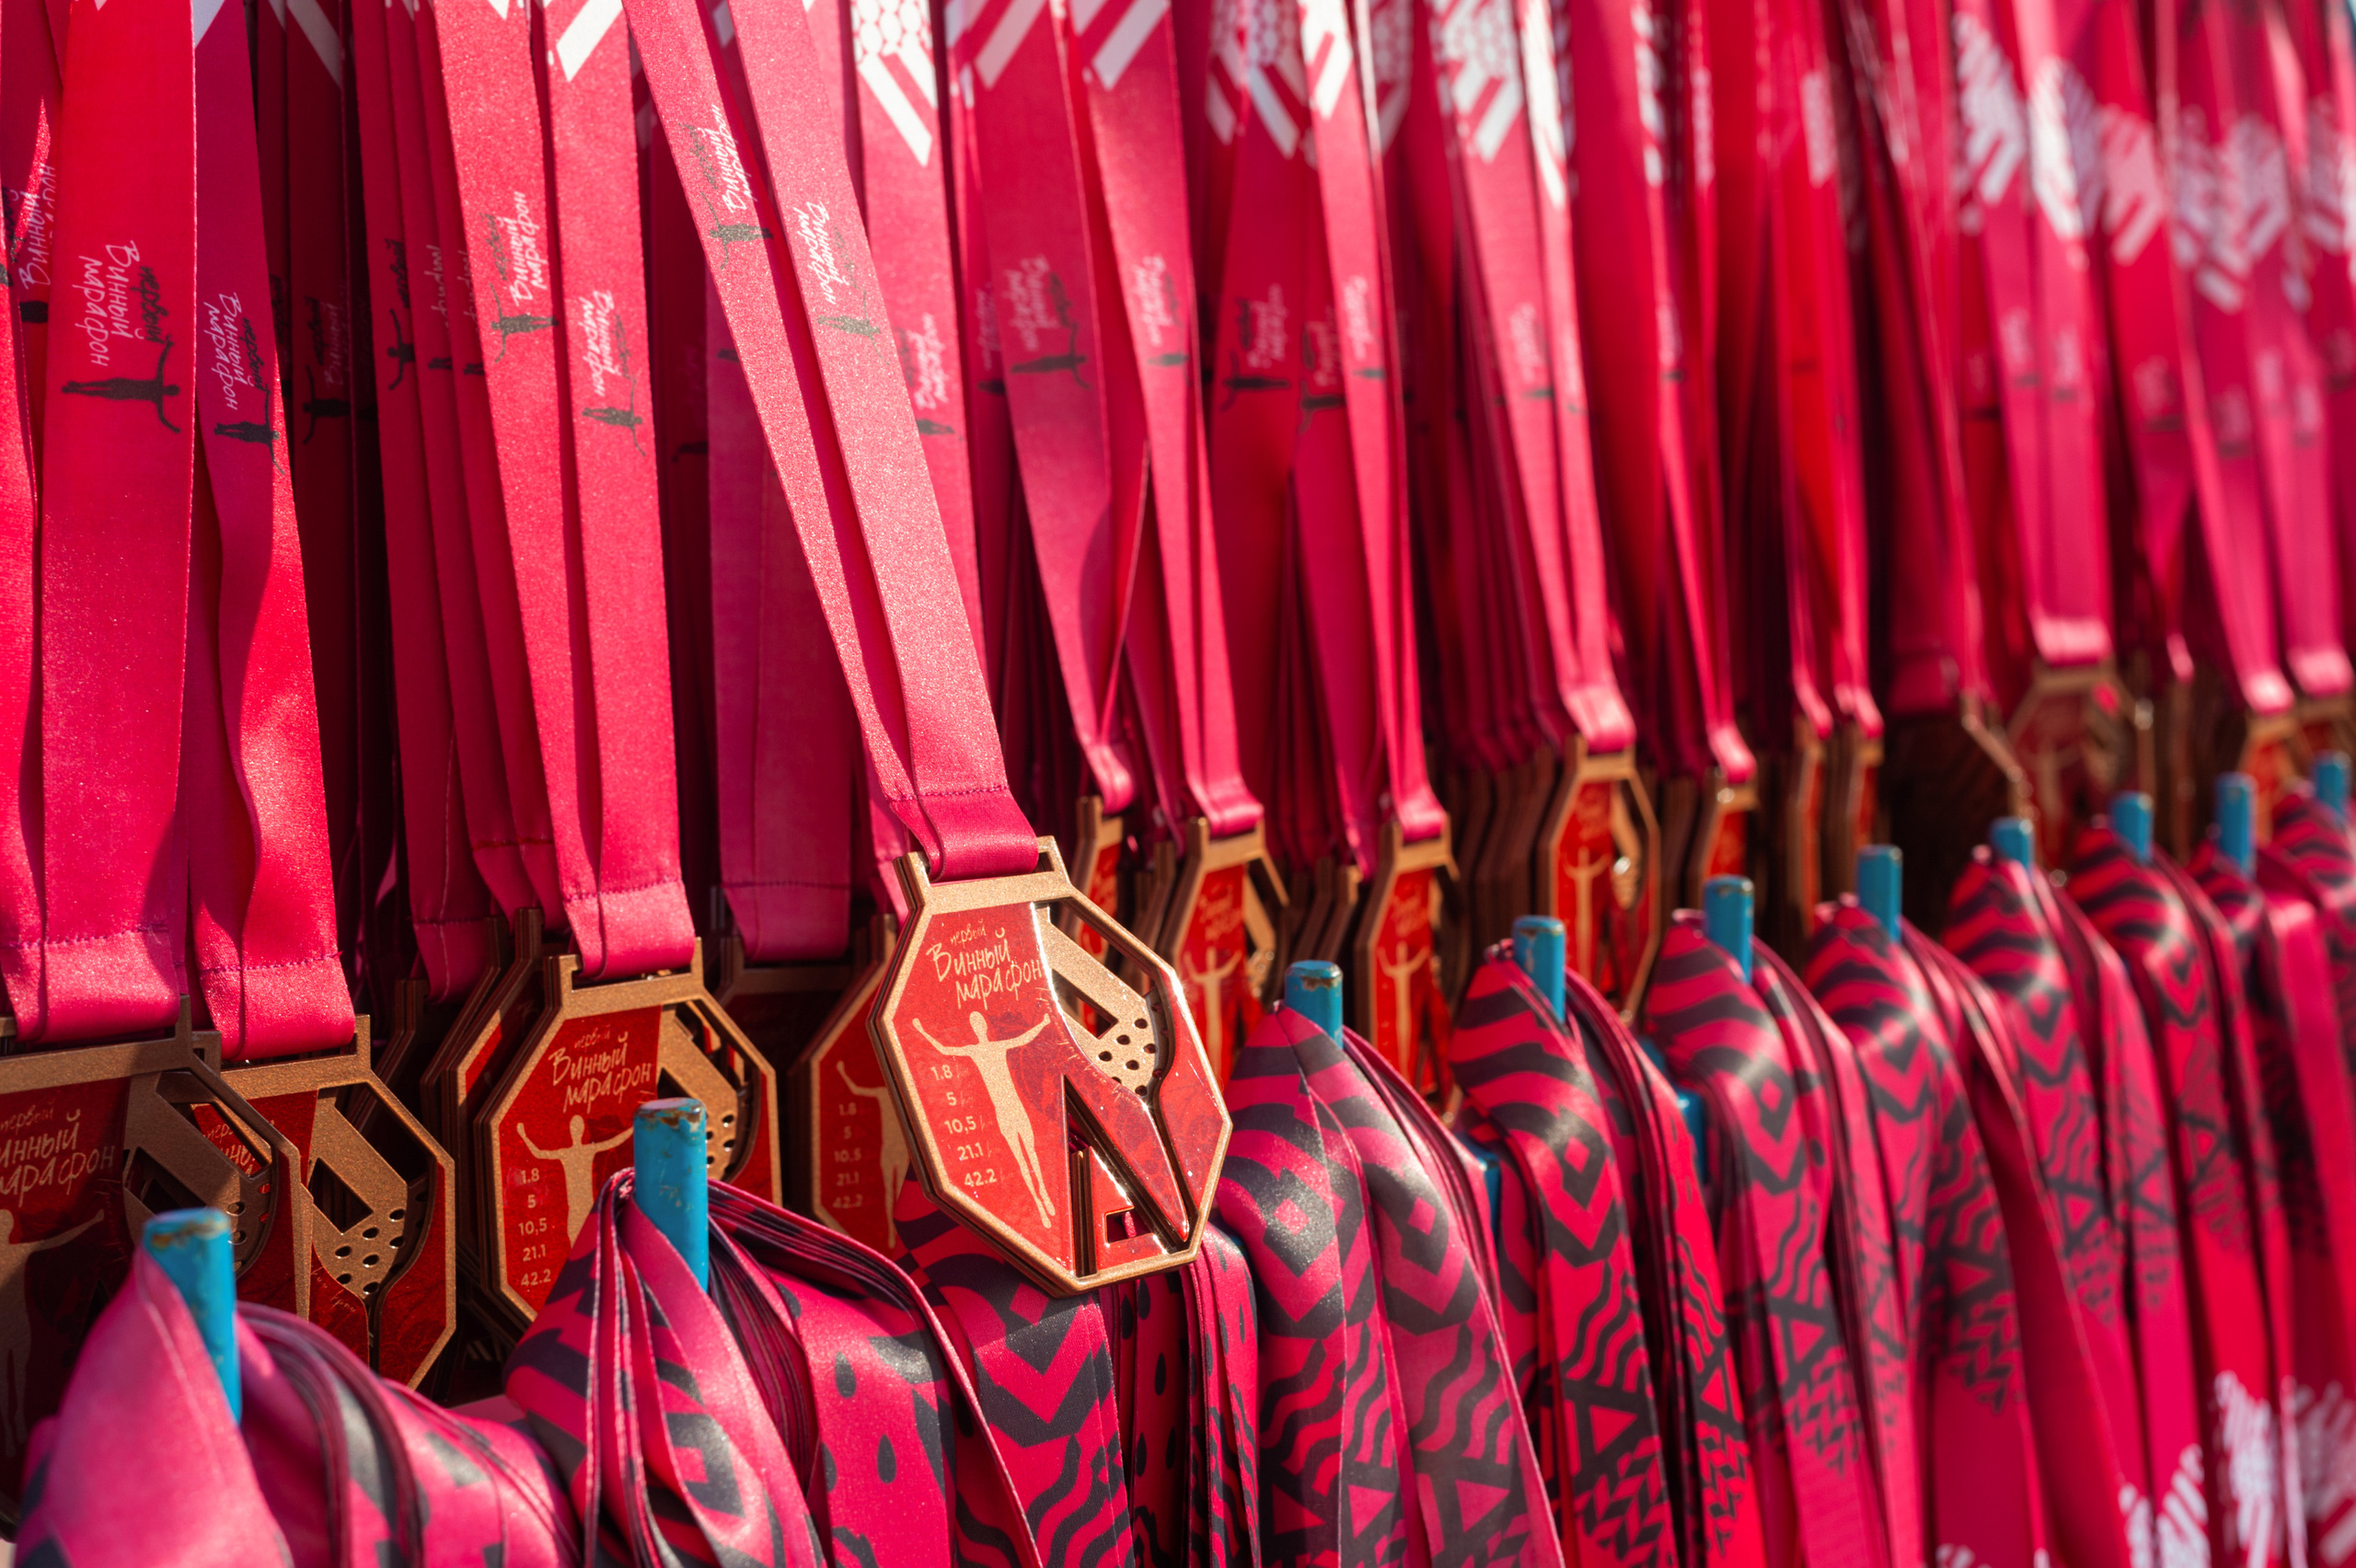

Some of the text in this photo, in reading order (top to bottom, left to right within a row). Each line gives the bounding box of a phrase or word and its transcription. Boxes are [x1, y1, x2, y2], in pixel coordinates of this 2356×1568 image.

[697, 127, 747, 213] Винный
[9, 189, 52, 290] Винный
[497, 215, 533, 307] Винный
[514, 190, 548, 290] марафон
[72, 255, 110, 366] марафон
[105, 239, 144, 340] Винный
[203, 301, 238, 410] марафон
[219, 292, 255, 386] Винный
[926, 927, 1011, 982] Винный
[955, 959, 1043, 1010] марафон
[548, 1031, 629, 1087] Винный
[930, 1065, 953, 1081] 1.8
[562, 1063, 652, 1115] марафон
[946, 1091, 957, 1106] 5
[0, 1109, 81, 1169] инный
[944, 1115, 977, 1135] 10,5
[957, 1142, 984, 1161] 21.1
[0, 1146, 116, 1208] арафон
[521, 1167, 540, 1184] 1.8
[527, 1194, 537, 1208] 5
[964, 1168, 998, 1187] 42.2
[518, 1217, 548, 1236] 10,5
[523, 1244, 546, 1262] 21.1
[520, 1269, 551, 1286] 42.2
